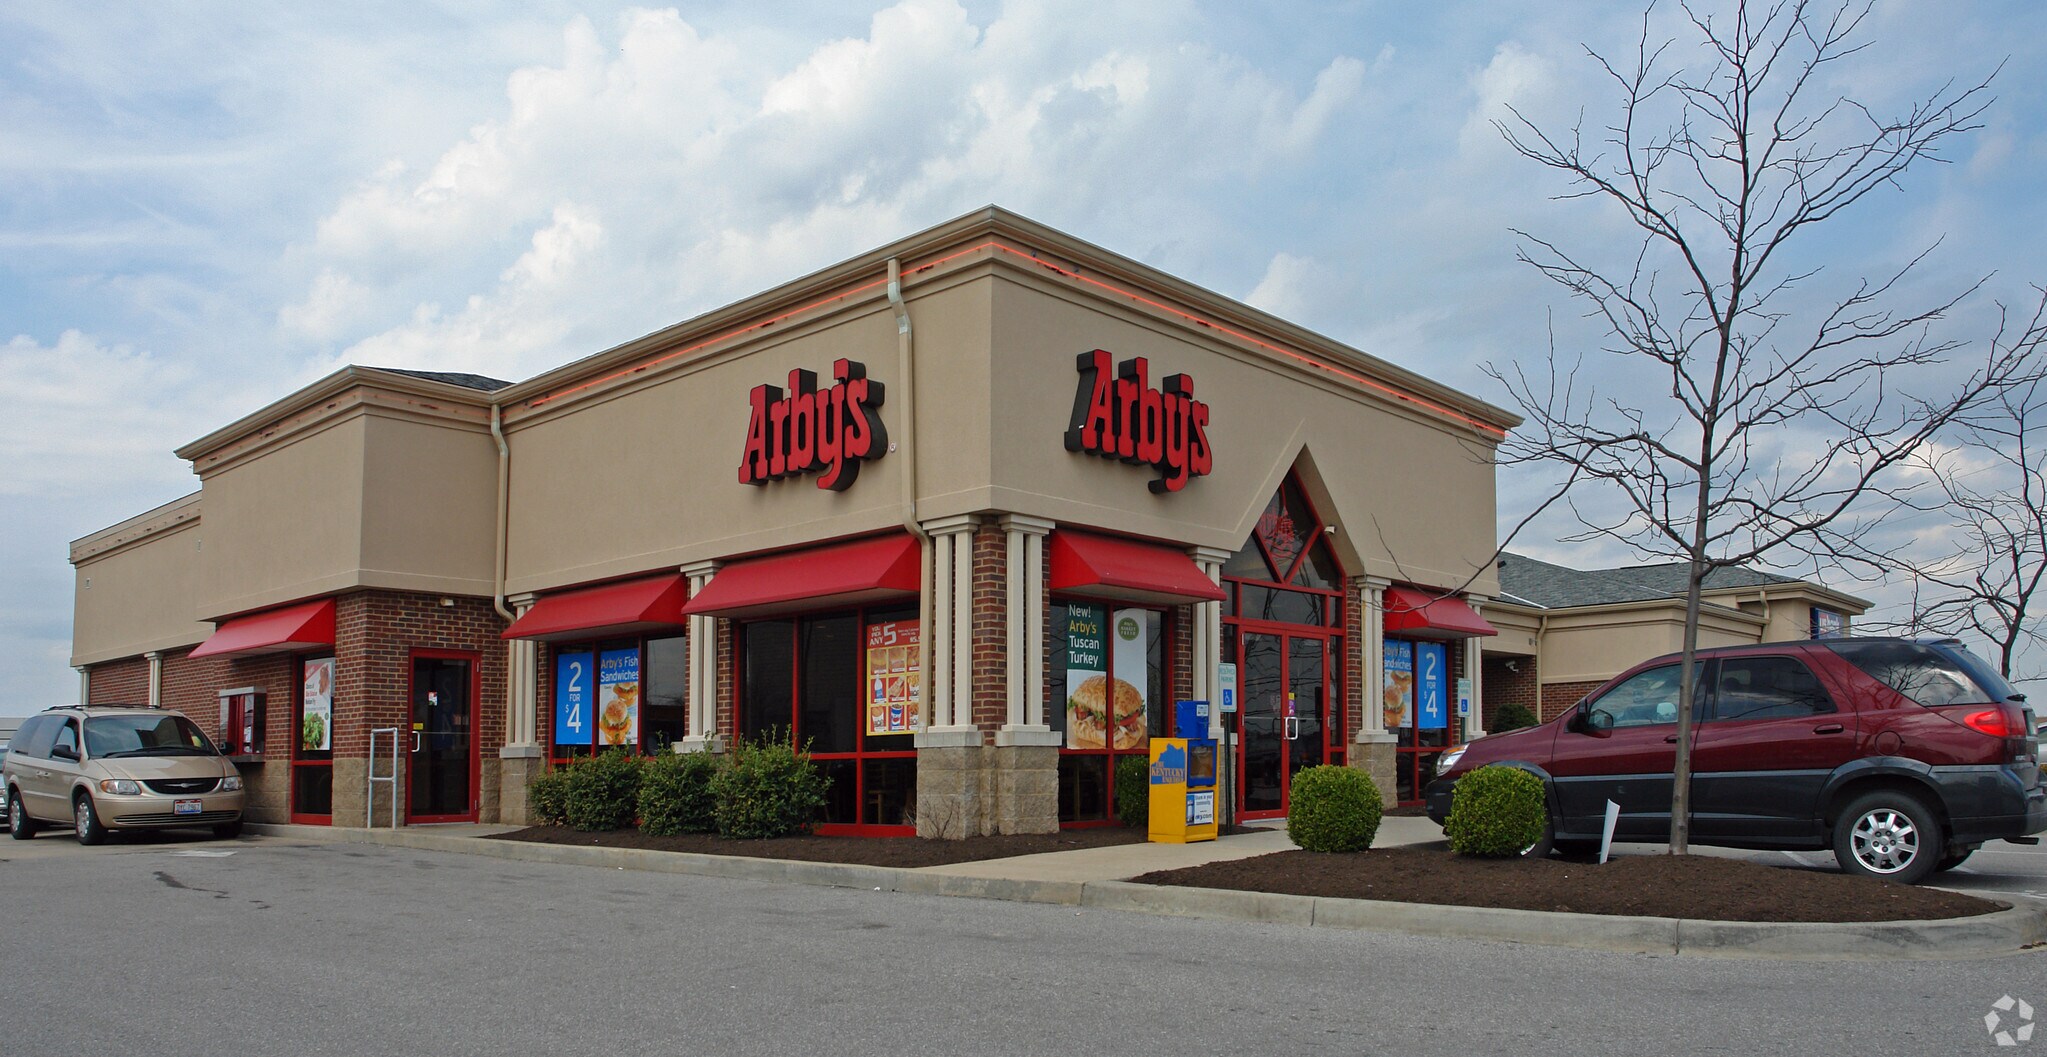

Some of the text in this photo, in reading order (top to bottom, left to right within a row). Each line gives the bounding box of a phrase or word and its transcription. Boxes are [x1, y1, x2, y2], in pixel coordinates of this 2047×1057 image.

[738, 357, 877, 491] Arby's
[1075, 349, 1212, 492] Arby's
[1068, 604, 1091, 618] New!
[883, 623, 897, 646] 5
[1069, 620, 1097, 636] Arby's
[869, 636, 884, 647] ANY
[1069, 635, 1100, 649] Tuscan
[1069, 651, 1099, 668] Turkey
[1399, 647, 1411, 658] Fish
[600, 655, 639, 670] Arby's Fish
[1425, 652, 1437, 681] 2
[568, 661, 582, 692] 2
[600, 669, 639, 682] Sandwiches
[1426, 681, 1437, 690] FOR
[570, 693, 581, 702] FOR
[1150, 767, 1185, 777] KENTUCKY
